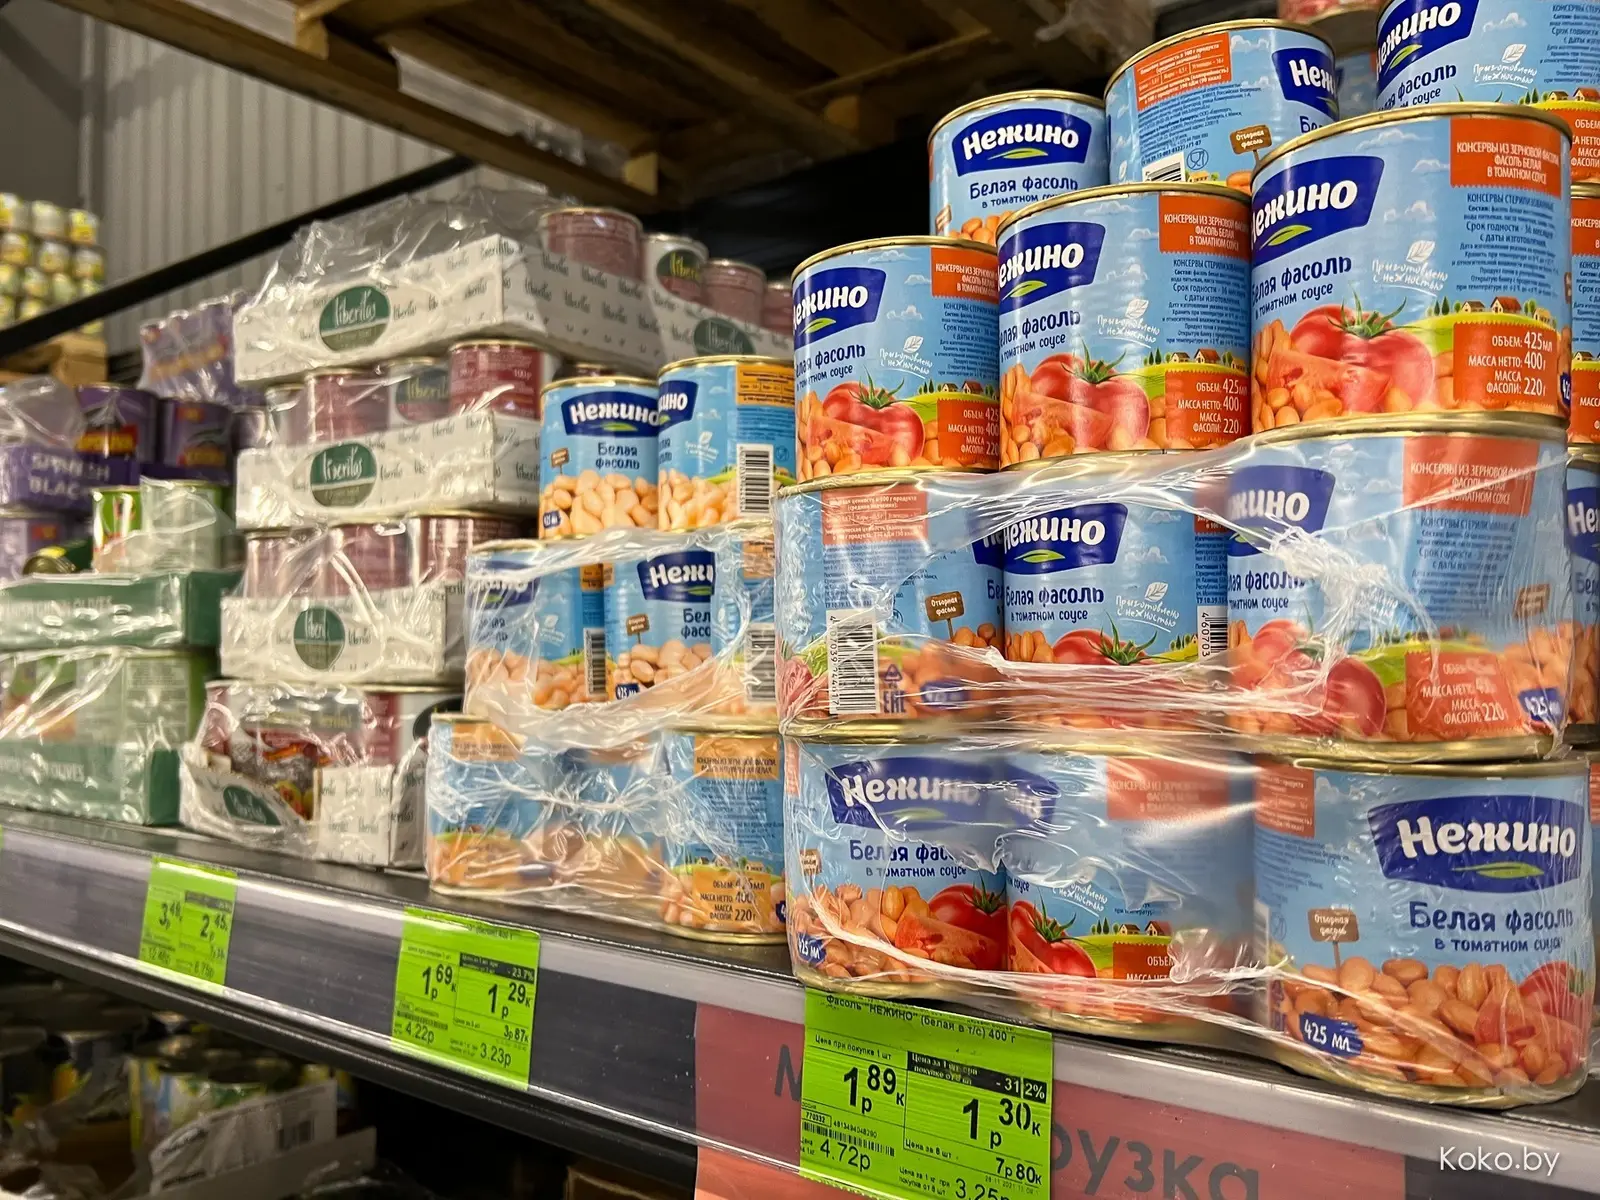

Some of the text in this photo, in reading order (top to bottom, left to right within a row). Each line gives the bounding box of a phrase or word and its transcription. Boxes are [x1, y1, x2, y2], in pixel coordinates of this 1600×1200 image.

[1397, 64, 1457, 101] фасоль
[1412, 88, 1441, 107] соусе
[961, 122, 1080, 161] Нежино
[1456, 141, 1499, 154] КОНСЕРВЫ
[1494, 154, 1522, 166] ФАСОЛЬ
[1493, 165, 1532, 180] ТОМАТНОМ
[969, 176, 1079, 200] Белая фасоль
[991, 195, 1039, 207] томатном
[1467, 193, 1504, 203] КОНСЕРВЫ
[1164, 213, 1199, 224] КОНСЕРВЫ
[1466, 221, 1519, 233] Срок годности
[1485, 235, 1505, 244] даты
[935, 263, 965, 274] КОНСЕРВЫ
[1281, 254, 1353, 292] фасоль
[1173, 282, 1217, 294] Срок годности
[1301, 281, 1335, 302] соусе
[1188, 294, 1205, 303] даты
[1021, 309, 1081, 337] фасоль
[1039, 334, 1066, 352] соусе
[1492, 334, 1523, 349] ОБЪЕМ:
[815, 343, 866, 369] фасоль
[1468, 355, 1523, 369] МАССА НЕТТО:
[830, 364, 853, 378] соусе
[1494, 370, 1522, 382] МАССА
[1196, 381, 1222, 394] ОБЪЕМ:
[1486, 381, 1522, 395] ФАСОЛИ:
[1177, 399, 1222, 411] МАССА НЕТТО:
[569, 400, 660, 427] Нежино
[1199, 412, 1222, 423] МАССА
[948, 424, 967, 433] МАССА
[966, 436, 985, 445] МАССА
[597, 442, 638, 457] Белая
[595, 457, 640, 470] фасоль
[29, 476, 84, 500] BLAC
[1005, 586, 1104, 608] Белая фасоль
[935, 606, 957, 617] фасоль
[1262, 597, 1288, 613] соусе
[1015, 609, 1088, 625] томатном соусе
[1452, 699, 1479, 711] МАССА
[1396, 815, 1577, 859] Нежино
[876, 868, 936, 879] томатном
[1012, 878, 1030, 894] соусе
[1409, 901, 1574, 936] Белая фасоль
[1434, 938, 1528, 952] в томатном
[422, 965, 432, 996] 1
[436, 963, 453, 985] 69
[431, 988, 438, 1001] р
[488, 984, 498, 1014] 1
[508, 982, 527, 1004] 29
[501, 1005, 510, 1020] р
[825, 994, 863, 1012] Фасоль
[919, 1015, 956, 1032] (белая
[958, 1023, 965, 1032] в
[966, 1024, 986, 1040] т/с)
[988, 1029, 1007, 1042] 400
[1010, 1034, 1016, 1043] г
[1304, 1018, 1350, 1052] 425 мл
[815, 1034, 892, 1061] Цена при покупке 1 шт
[480, 1042, 512, 1069] 3.23р
[910, 1052, 931, 1065] Цена
[843, 1063, 906, 1107] 1 89 к
[1004, 1076, 1046, 1101] 312%
[861, 1097, 873, 1115] р
[962, 1097, 1042, 1141] 1 30 к
[989, 1131, 1003, 1150] р
[819, 1138, 871, 1173] 4.72р
[905, 1138, 952, 1160] Цена за шт
[898, 1165, 916, 1178] Цена
[936, 1187, 947, 1197] шт
